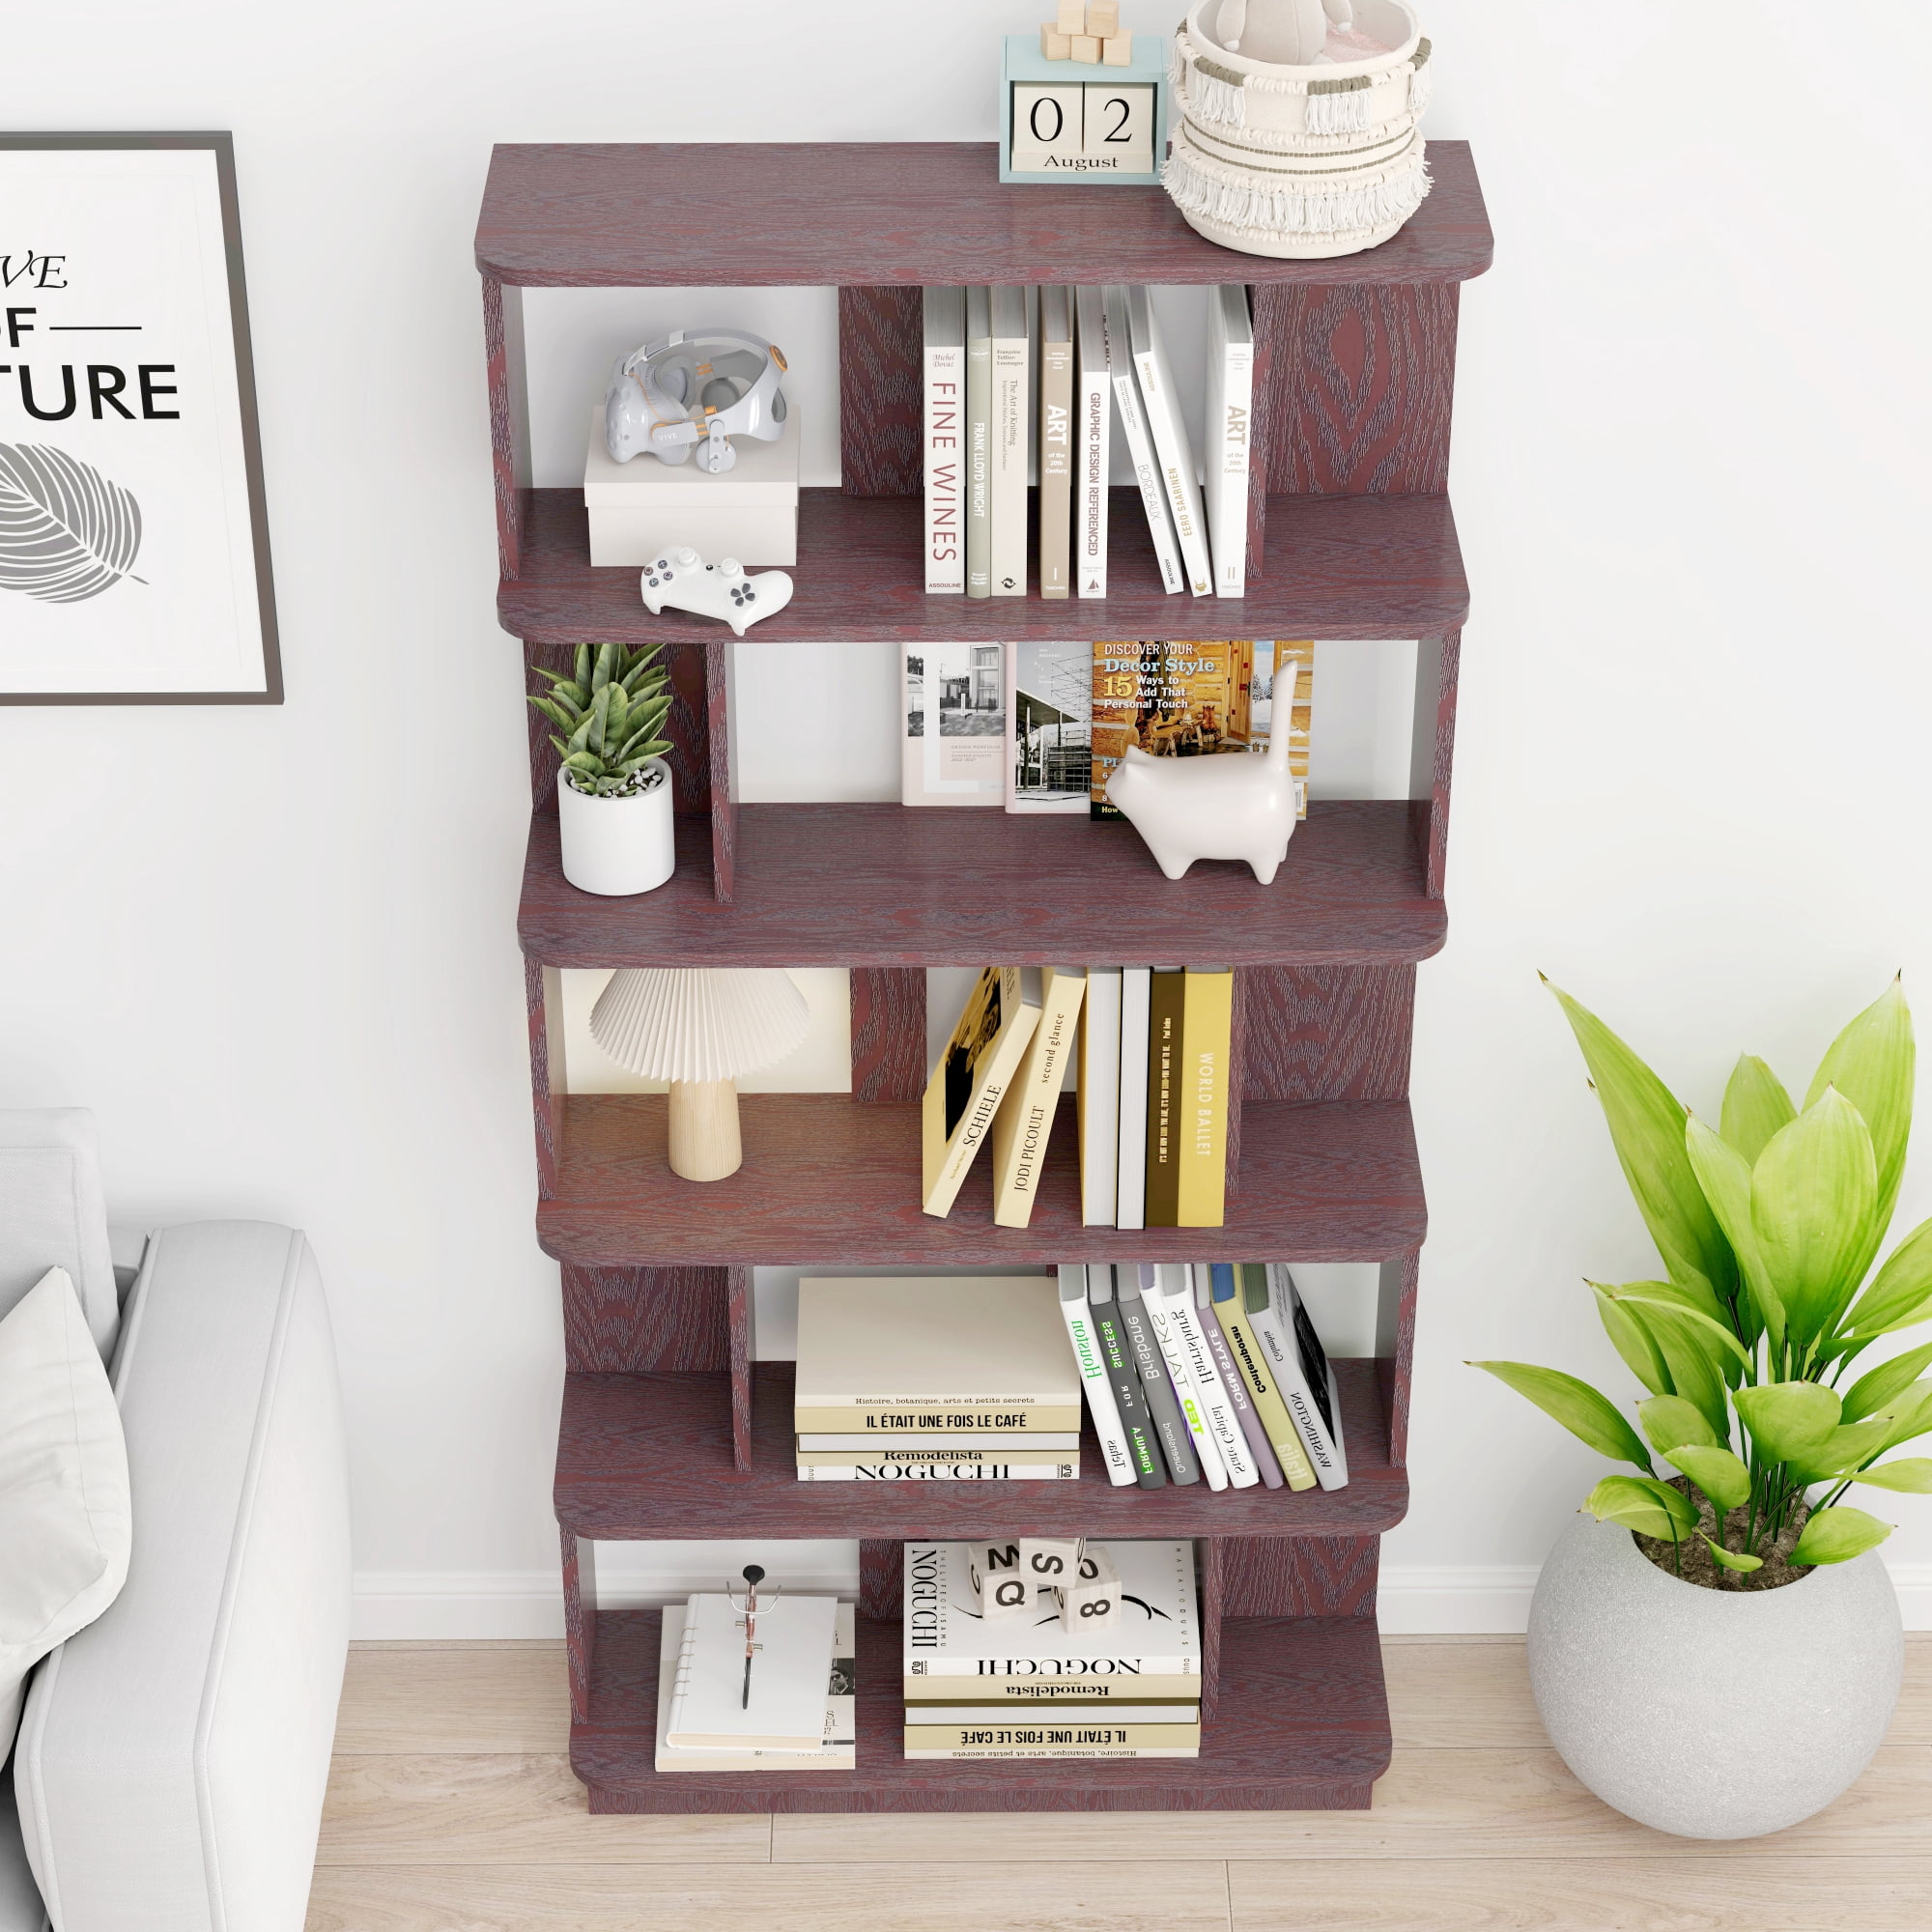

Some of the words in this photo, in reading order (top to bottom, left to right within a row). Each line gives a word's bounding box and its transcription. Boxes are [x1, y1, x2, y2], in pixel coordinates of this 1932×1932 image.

[1043, 155, 1119, 171] August
[0, 307, 37, 348] F
[1009, 379, 1018, 393] The
[1009, 395, 1018, 407] Art
[1009, 408, 1018, 416] of
[932, 383, 956, 449] FINE
[1047, 405, 1067, 445] ART
[1090, 392, 1101, 441] GRAPHIC
[1227, 406, 1247, 445] ART
[974, 422, 986, 451] FRANK
[1008, 417, 1018, 446] Knitting
[974, 453, 986, 482] LLOYD
[1089, 443, 1101, 484] DESIGN
[974, 482, 986, 518] WRIGHT
[1138, 465, 1162, 521] BORDEAUX
[1168, 468, 1187, 513] SAARINEN
[932, 464, 957, 561] WINES
[1088, 486, 1100, 556] REFERENCED
[1179, 515, 1193, 536] EERO
[1104, 643, 1161, 656] DISCOVER
[1163, 643, 1193, 656] YOUR
[1104, 658, 1162, 673] Decor
[1165, 658, 1214, 674] Style
[1103, 676, 1133, 697] 15
[1136, 675, 1165, 688] Ways
[1168, 676, 1179, 686] to
[1136, 687, 1158, 697] Add
[1161, 686, 1186, 697] That
[1104, 698, 1152, 709] Personal
[1155, 698, 1189, 709] Touch
[1048, 1013, 1065, 1046] glance
[1041, 1049, 1056, 1084] second
[1197, 1052, 1214, 1103] WORLD
[963, 1085, 1002, 1147] SCHIELE
[1021, 1105, 1045, 1160] PICOULT
[1196, 1108, 1212, 1157] BALLET
[1014, 1164, 1032, 1192] JODI
[866, 1415, 878, 1428] IL
[881, 1412, 915, 1428] ÉTAIT
[919, 1414, 943, 1428] UNE
[947, 1414, 974, 1428] FOIS
[977, 1414, 992, 1427] LE
[996, 1412, 1027, 1427] CAFÉ
[884, 1451, 983, 1461] Remodelista
[854, 1464, 1009, 1479] NOGUCHI
[1031, 1552, 1064, 1575] S
[911, 1549, 938, 1648] NOGUCHI
[995, 1580, 1025, 1607] Q
[1080, 1599, 1111, 1618] 8
[977, 1659, 1142, 1675] NOGUCHI
[1006, 1686, 1110, 1696] Remodelista
[960, 1731, 993, 1747] CAFÉ
[996, 1731, 1011, 1744] LE
[1015, 1731, 1043, 1744] FOIS
[1047, 1730, 1072, 1744] UNE
[1077, 1730, 1112, 1746] ÉTAIT
[1115, 1730, 1126, 1744] IL
[987, 1749, 1013, 1758] petits
[1049, 1749, 1095, 1758] botanique,
